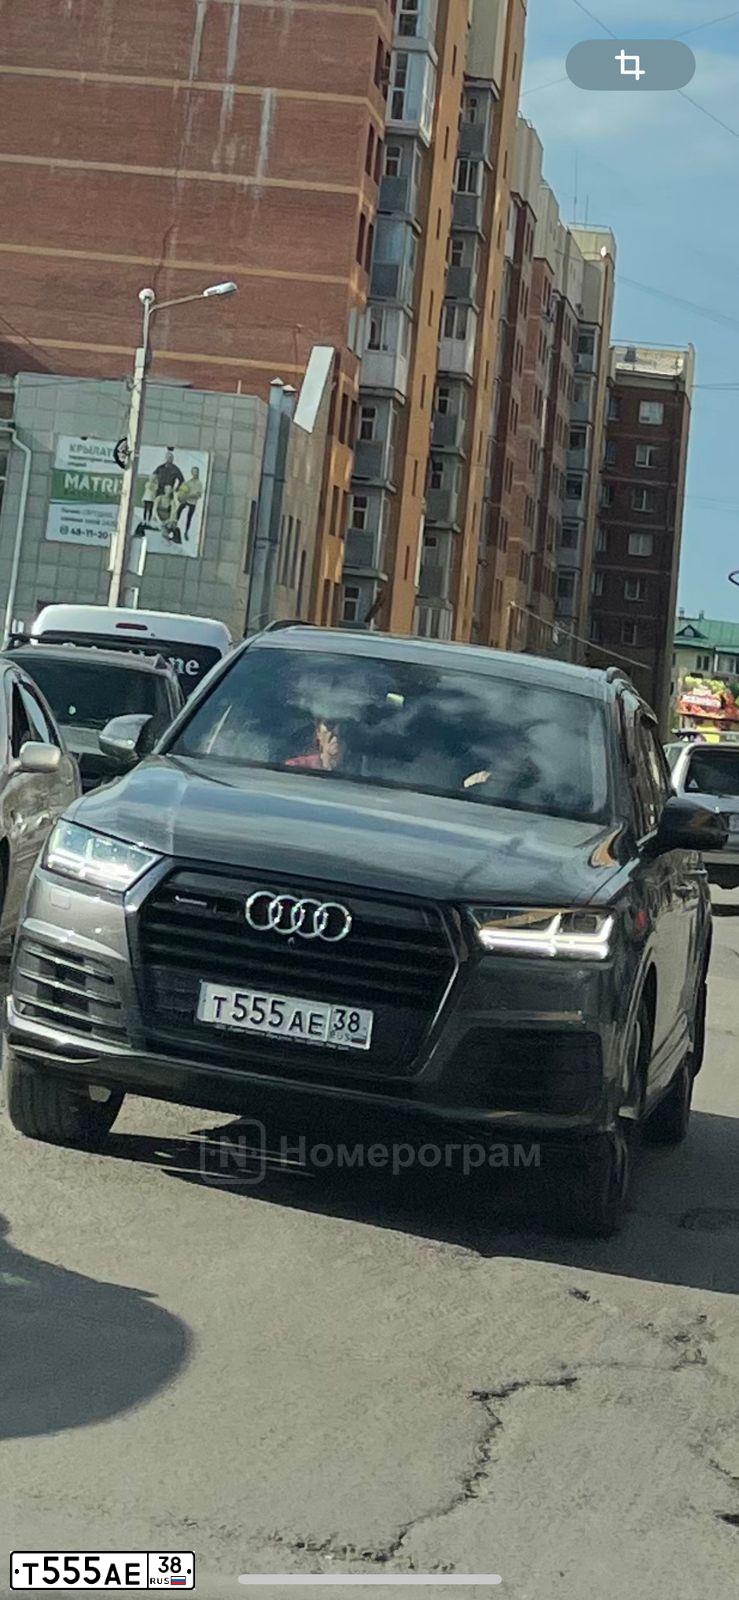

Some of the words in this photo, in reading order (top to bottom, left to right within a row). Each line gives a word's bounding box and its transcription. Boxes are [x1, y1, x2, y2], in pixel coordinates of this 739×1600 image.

[69, 443, 114, 458] КРЫЛАТ
[64, 473, 121, 494] MATRI
[213, 993, 323, 1035] Т555АЕ
[333, 1008, 360, 1033] 38
